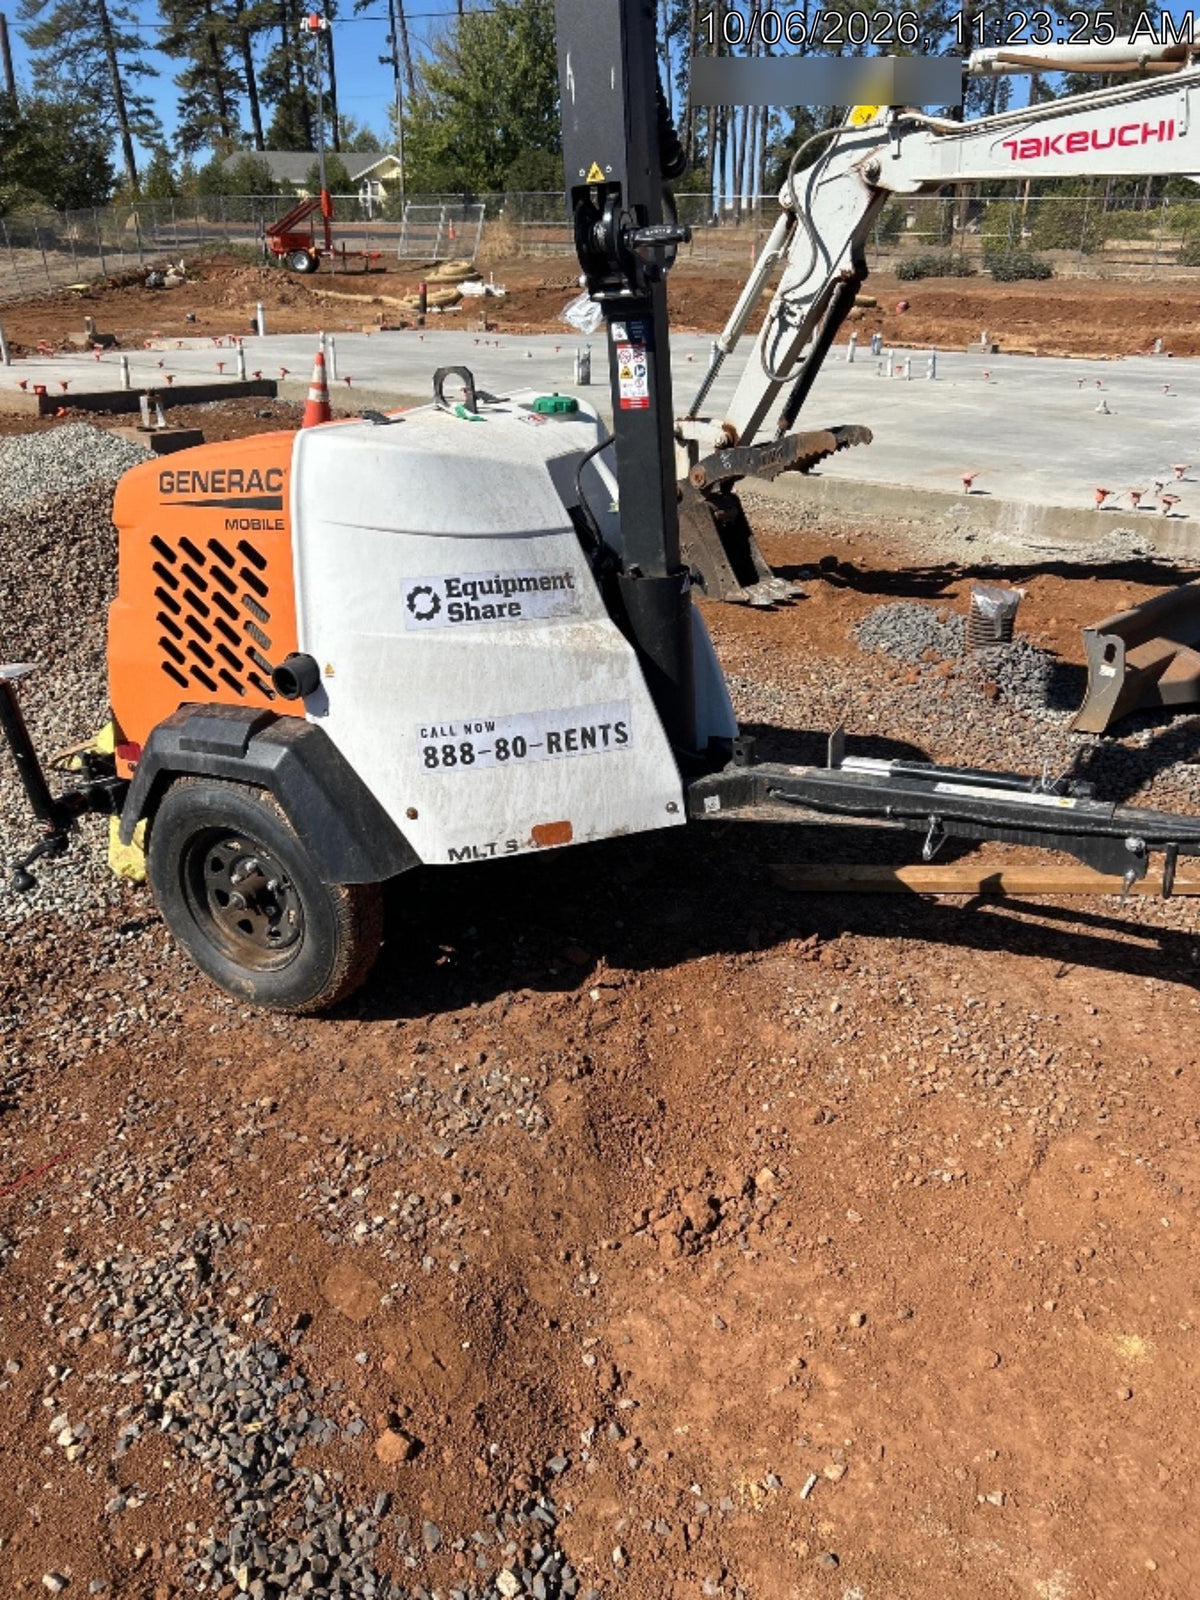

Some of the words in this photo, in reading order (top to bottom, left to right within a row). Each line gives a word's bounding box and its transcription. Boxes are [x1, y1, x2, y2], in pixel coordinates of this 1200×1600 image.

[159, 468, 283, 494] GENERAC
[225, 518, 285, 531] MOBILE
[444, 572, 575, 601] Equipment
[447, 602, 522, 623] Share
[420, 726, 457, 739] CALL
[464, 721, 496, 736] NOW
[423, 721, 629, 769] 888-80-RENTS
